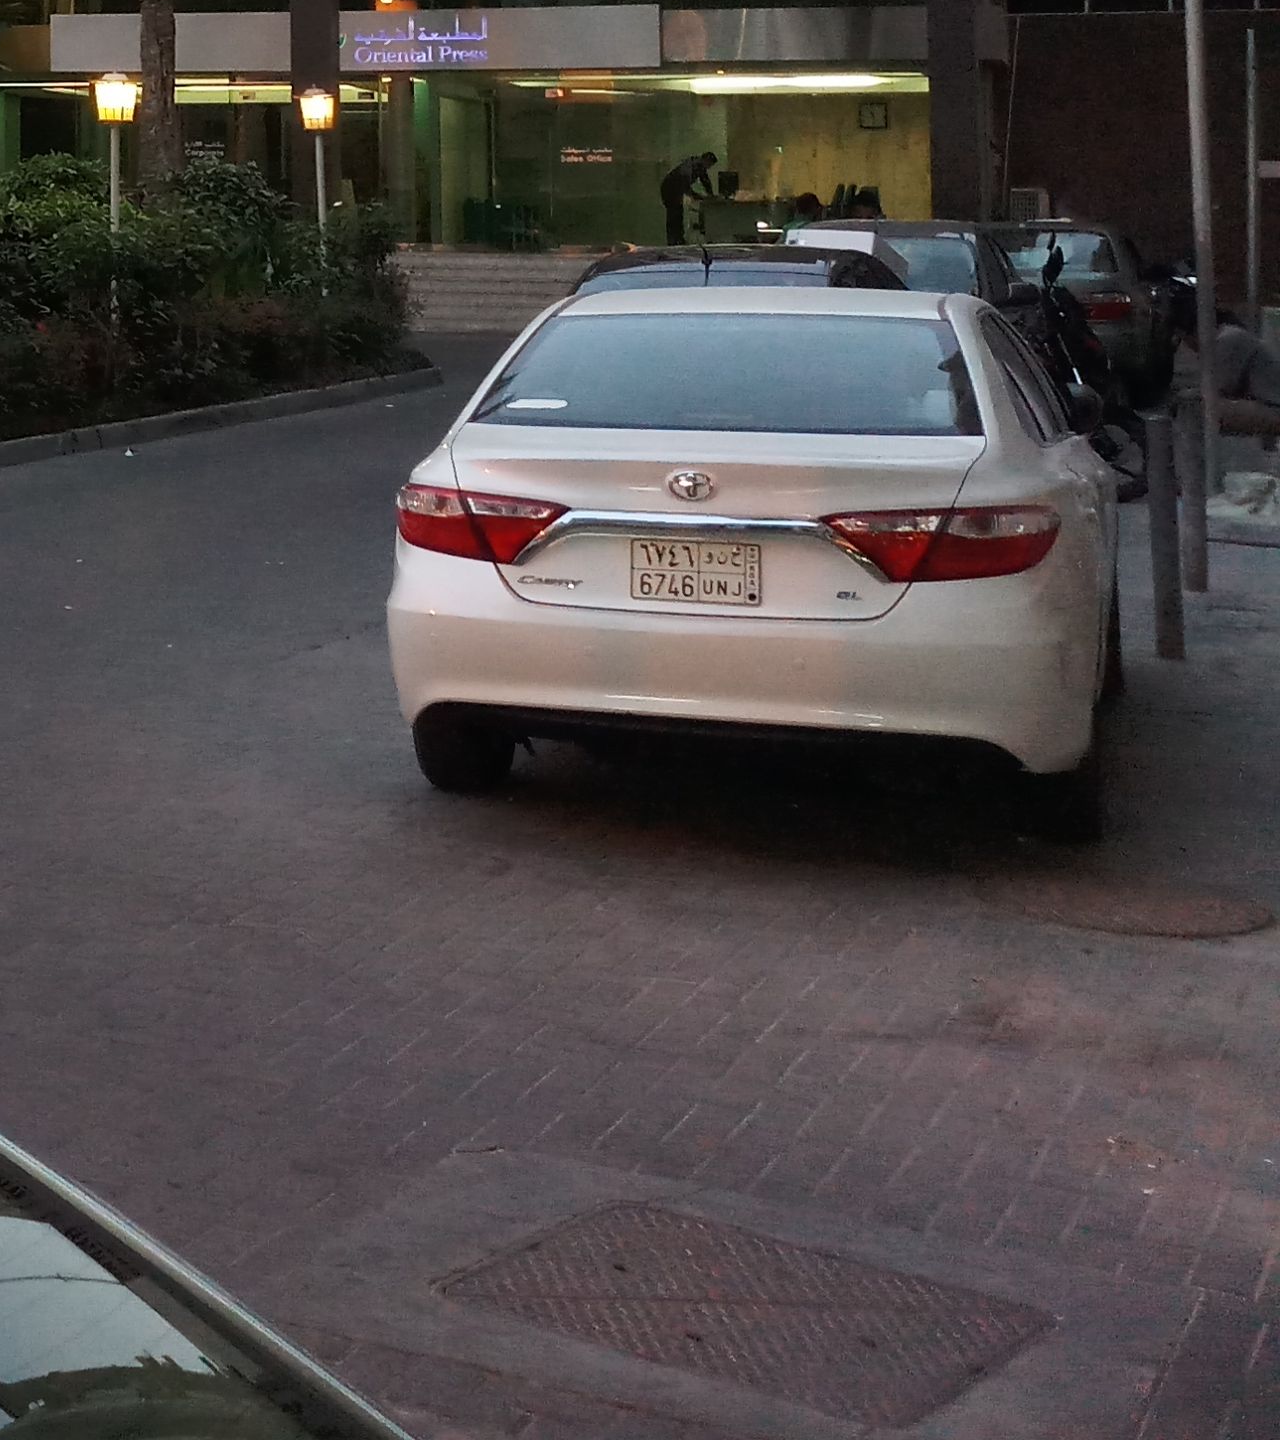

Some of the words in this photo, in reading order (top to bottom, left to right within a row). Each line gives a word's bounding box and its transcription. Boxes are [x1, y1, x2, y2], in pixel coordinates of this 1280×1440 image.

[354, 46, 433, 63] Oriental
[438, 45, 488, 63] Press
[640, 572, 694, 597] 6746
